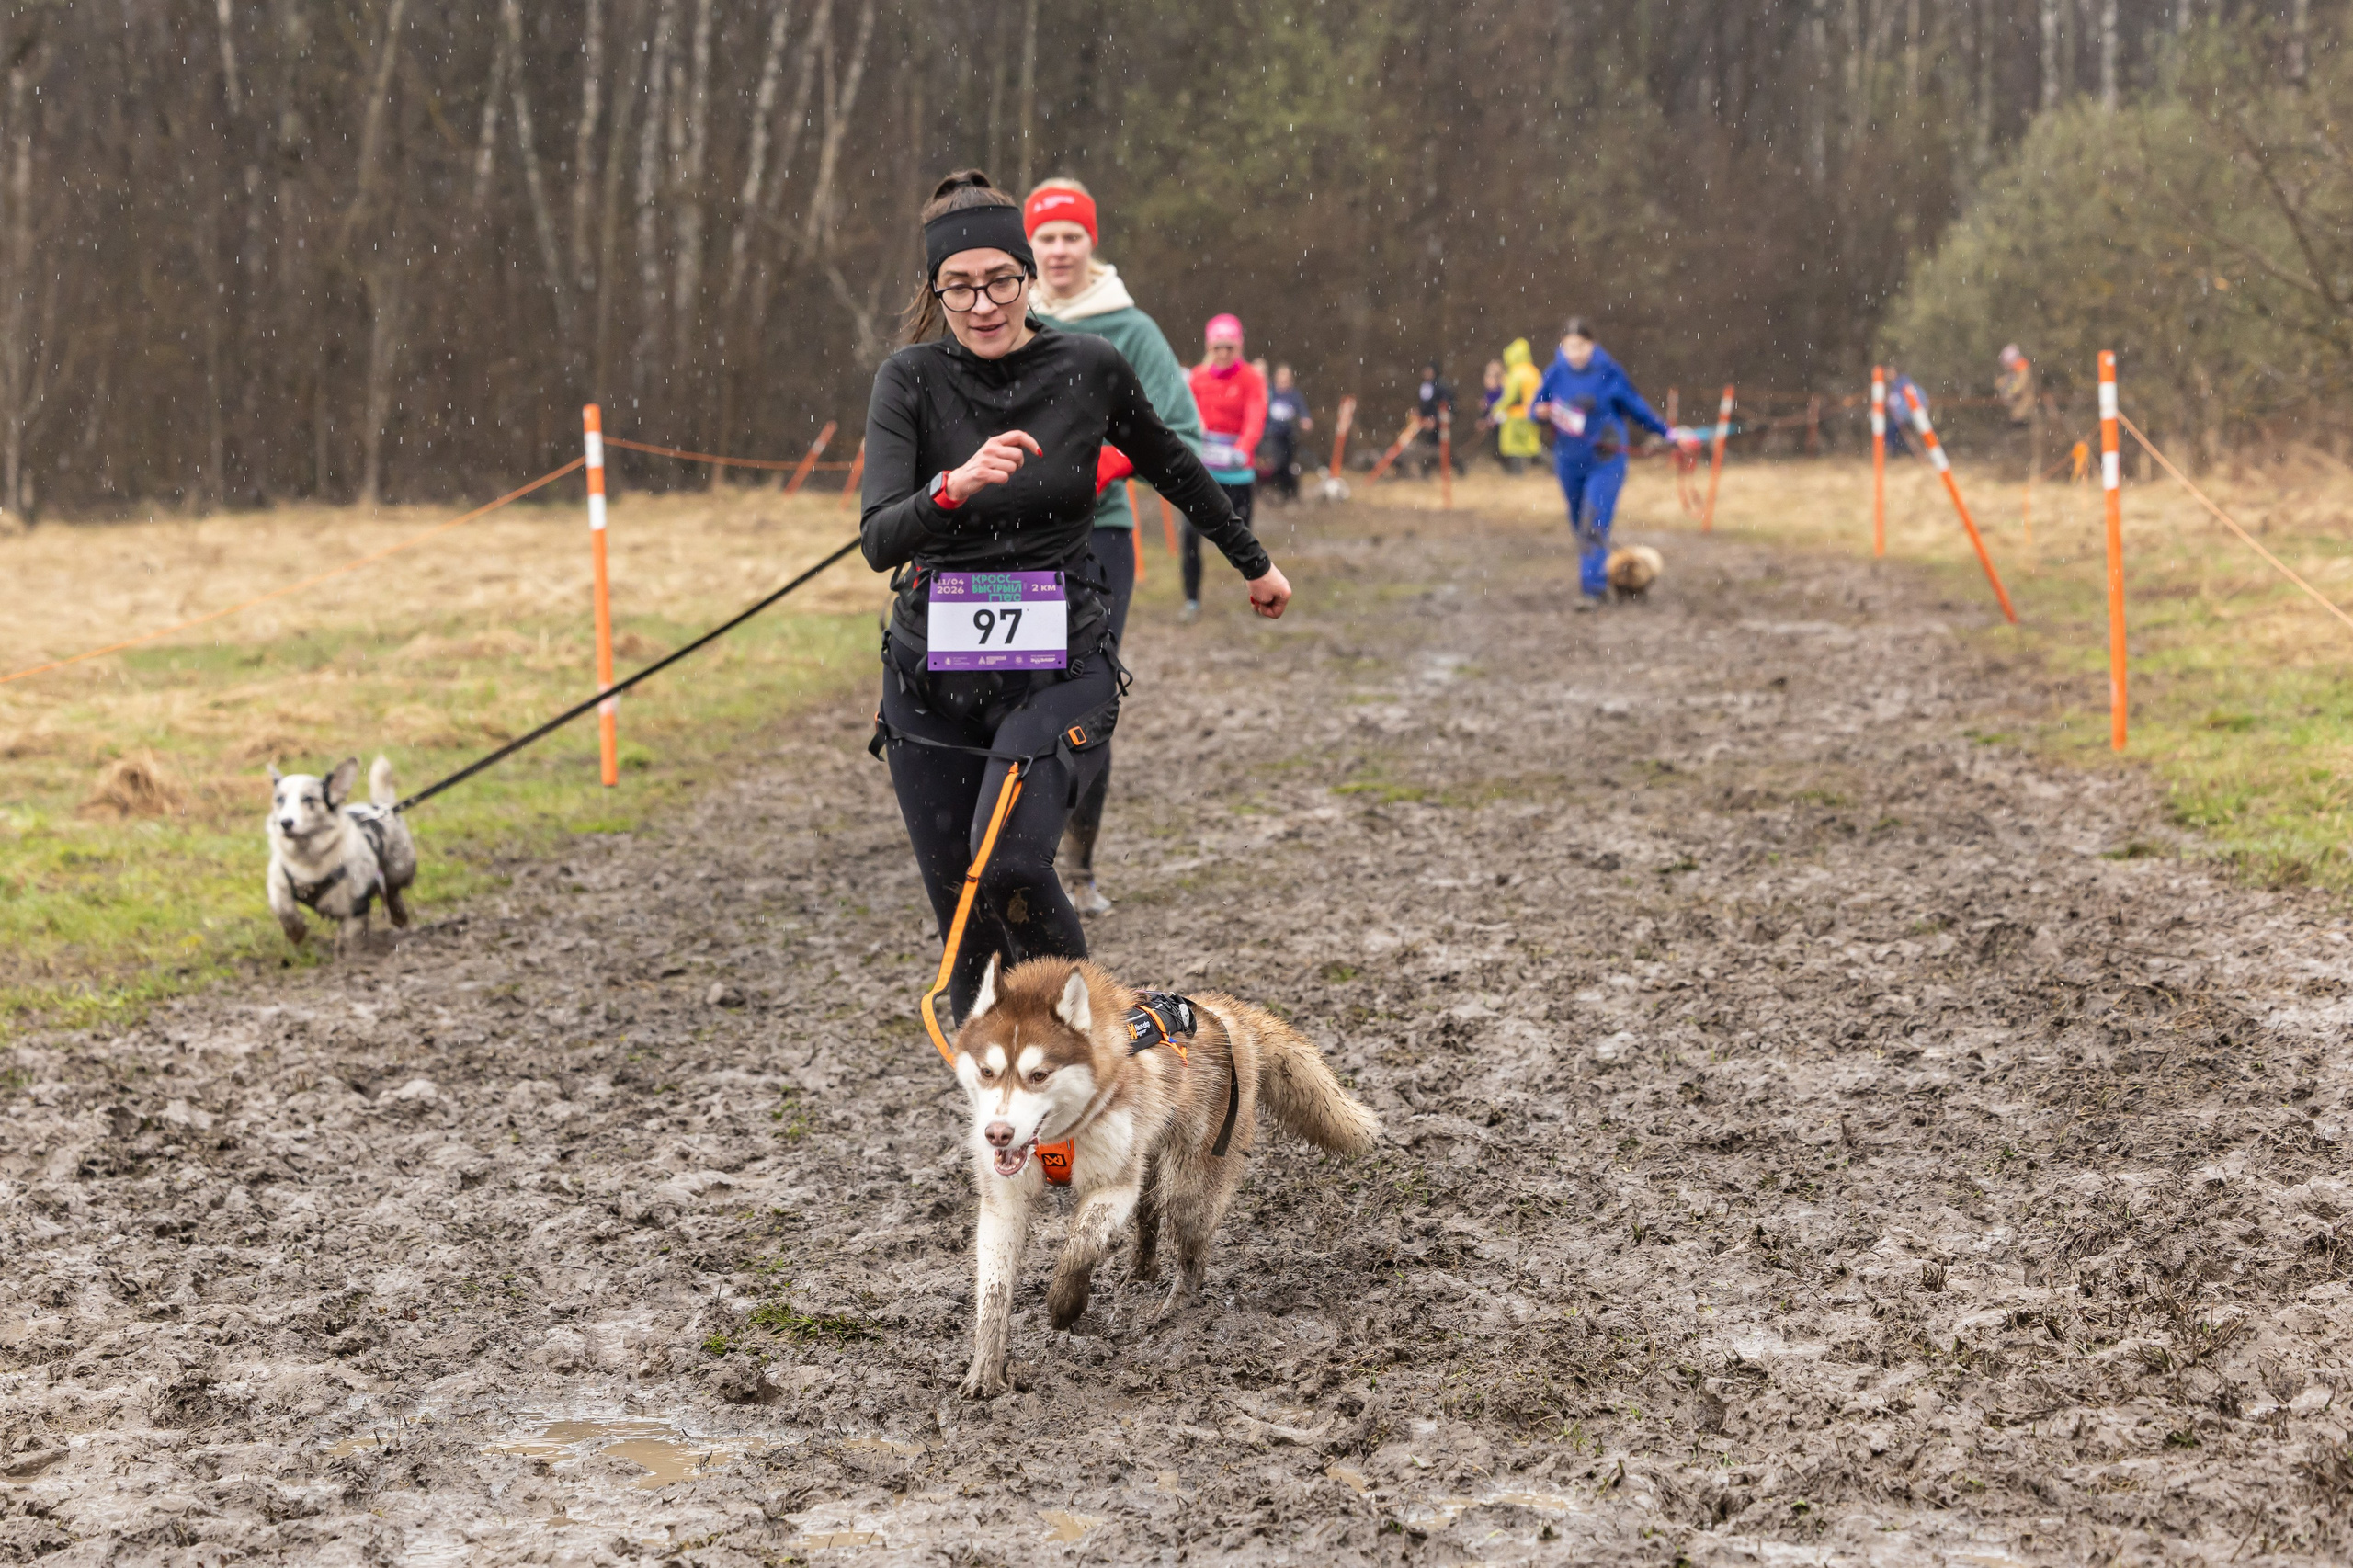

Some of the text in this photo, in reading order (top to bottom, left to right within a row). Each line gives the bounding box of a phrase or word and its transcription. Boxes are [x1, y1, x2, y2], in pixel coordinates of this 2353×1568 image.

[972, 574, 1011, 584] КРОСС
[937, 586, 964, 595] 2026
[1031, 584, 1039, 592] 2
[973, 608, 1022, 644] 97
